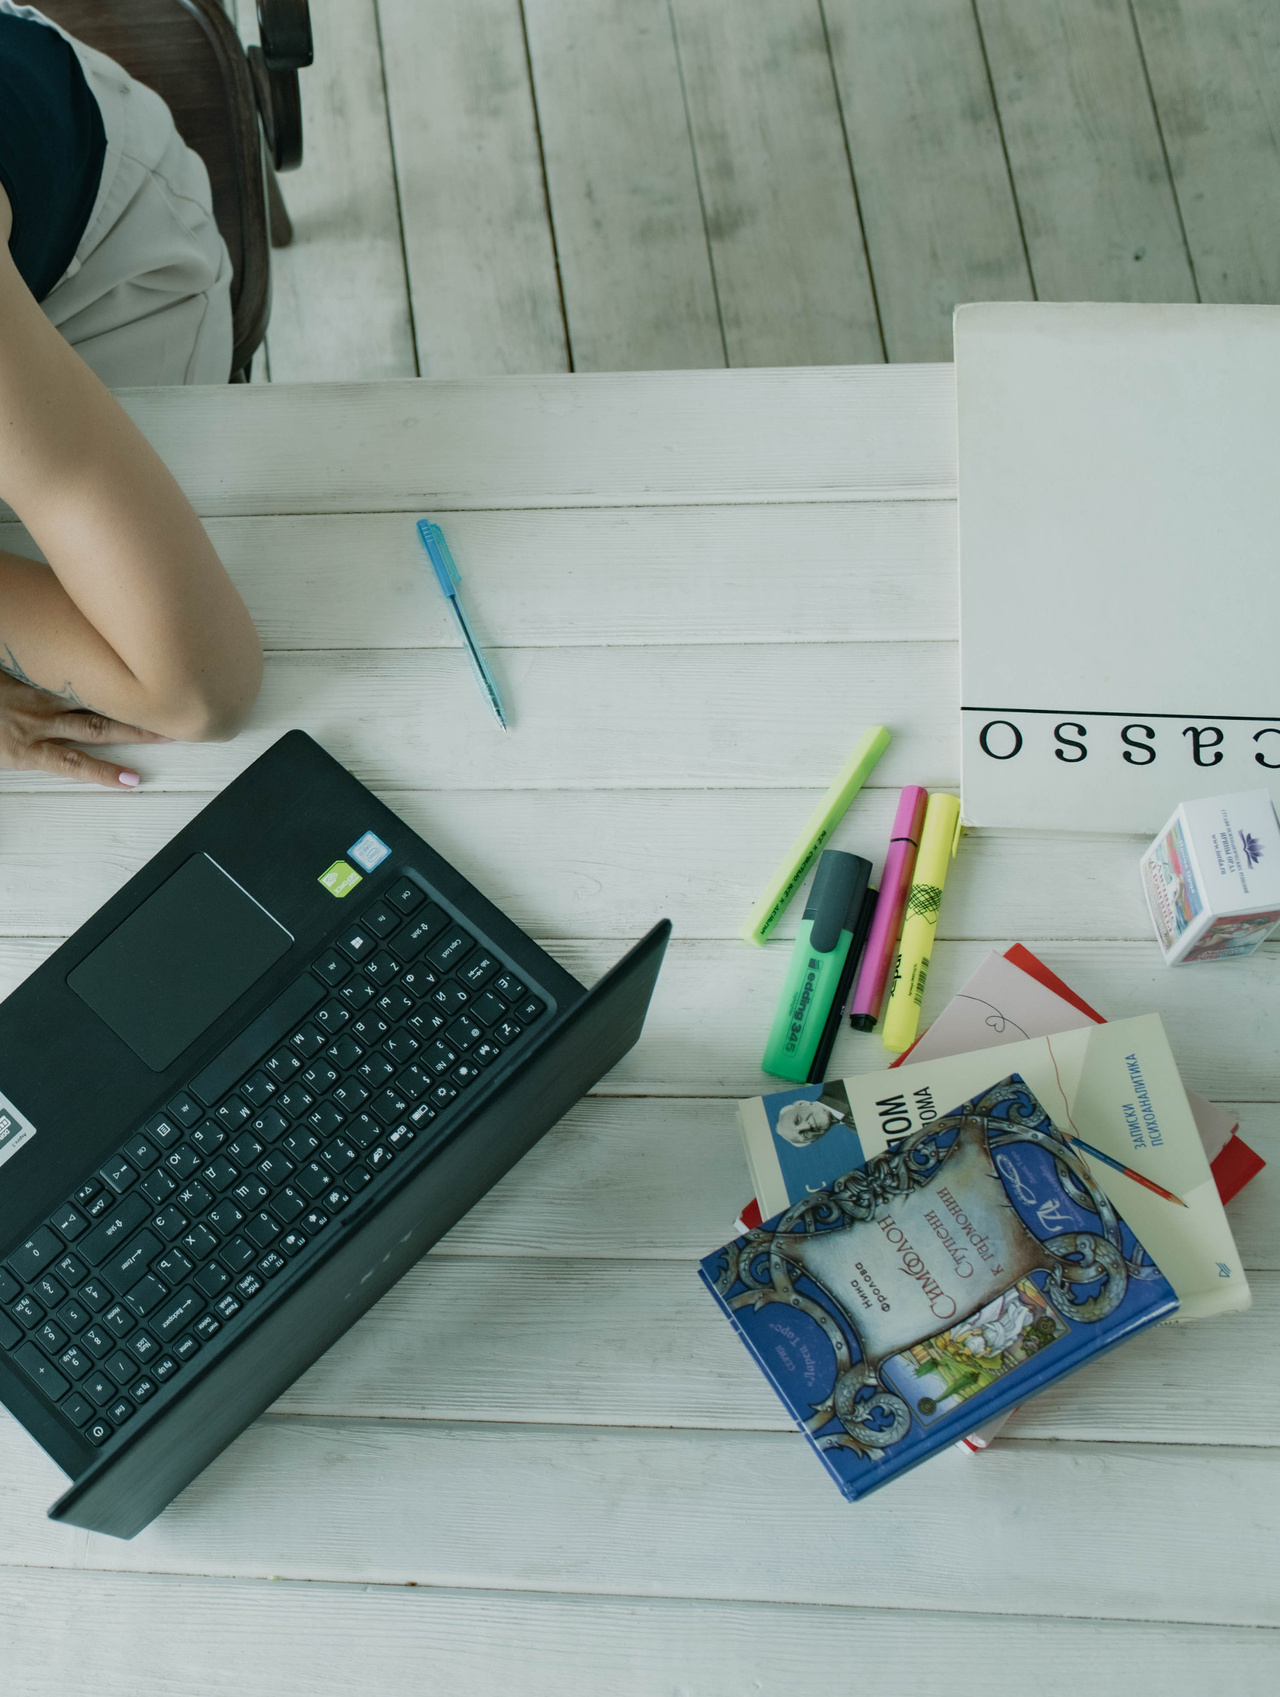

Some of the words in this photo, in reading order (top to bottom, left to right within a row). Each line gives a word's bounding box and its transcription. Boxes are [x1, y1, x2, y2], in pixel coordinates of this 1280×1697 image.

[333, 871, 356, 893] GEFORCE
[401, 890, 411, 900] Ctrl
[411, 928, 422, 938] Shift
[328, 962, 336, 970] Alt
[480, 959, 490, 967] Tab
[793, 970, 816, 1021] edding
[526, 1004, 536, 1013] Esc
[784, 1022, 801, 1052] 345
[1127, 1052, 1163, 1147] ПСИХОАНАЛИТИКА
[181, 1104, 189, 1112] Alt
[913, 1086, 938, 1127] ОМА
[1123, 1102, 1147, 1150] ЗАПИСКИ
[13, 1131, 27, 1145] Aspire
[137, 1146, 147, 1156] Ctrl
[106, 1225, 118, 1235] Shift
[936, 1186, 996, 1266] гармонии
[923, 1208, 975, 1280] Ступени
[121, 1258, 135, 1270] Enter
[239, 1275, 254, 1289] SysRq
[247, 1282, 259, 1294] PrtSc
[853, 1260, 891, 1314] Фролова
[849, 1278, 873, 1311] Нина
[219, 1296, 232, 1309] Break
[223, 1300, 238, 1315] Pause
[162, 1307, 184, 1328] Backspace
[198, 1317, 212, 1329] Delete
[208, 1322, 219, 1332] Insert
[136, 1337, 148, 1348] Lock
[138, 1340, 151, 1352] Num
[179, 1340, 193, 1353] Home
[774, 1343, 796, 1373] СЕРИЯ
[115, 1405, 125, 1415] End
